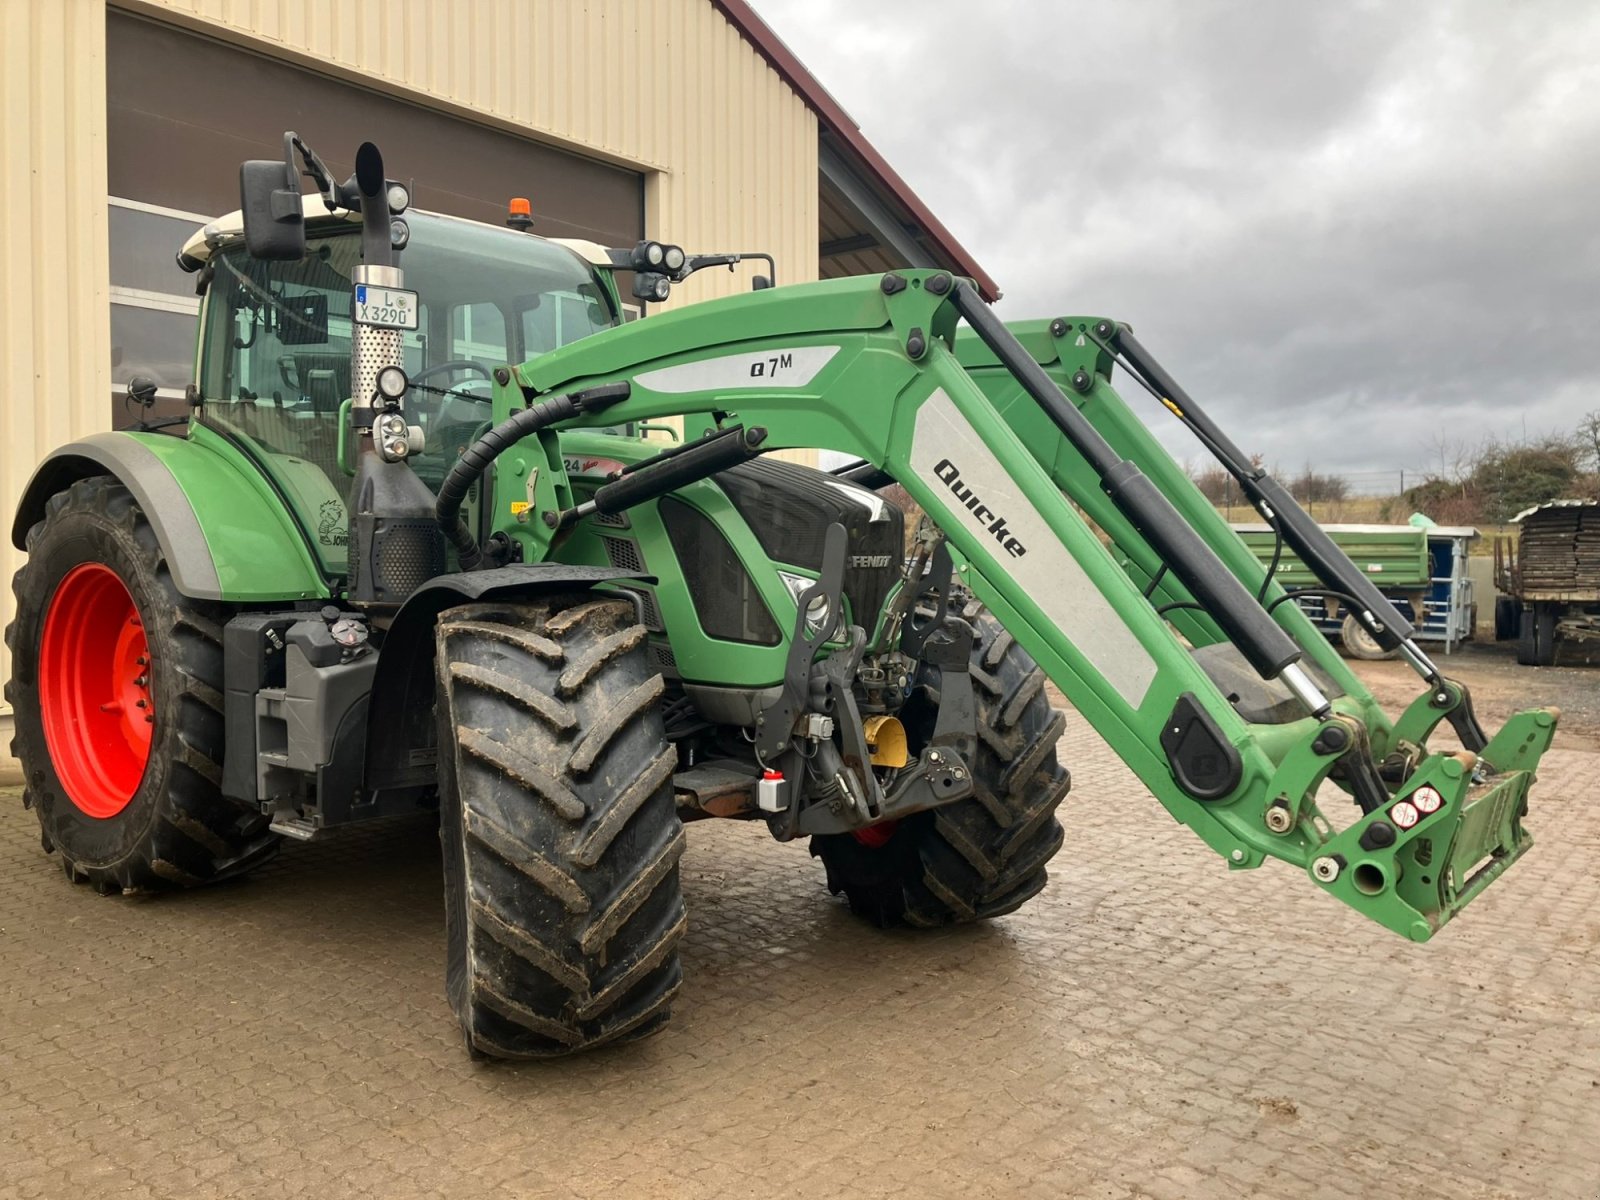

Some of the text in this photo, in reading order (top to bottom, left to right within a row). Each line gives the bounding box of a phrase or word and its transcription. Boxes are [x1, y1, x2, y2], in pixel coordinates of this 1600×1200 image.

[385, 292, 393, 307] L
[933, 459, 1027, 558] Quicke
[851, 555, 892, 568] FENDT
